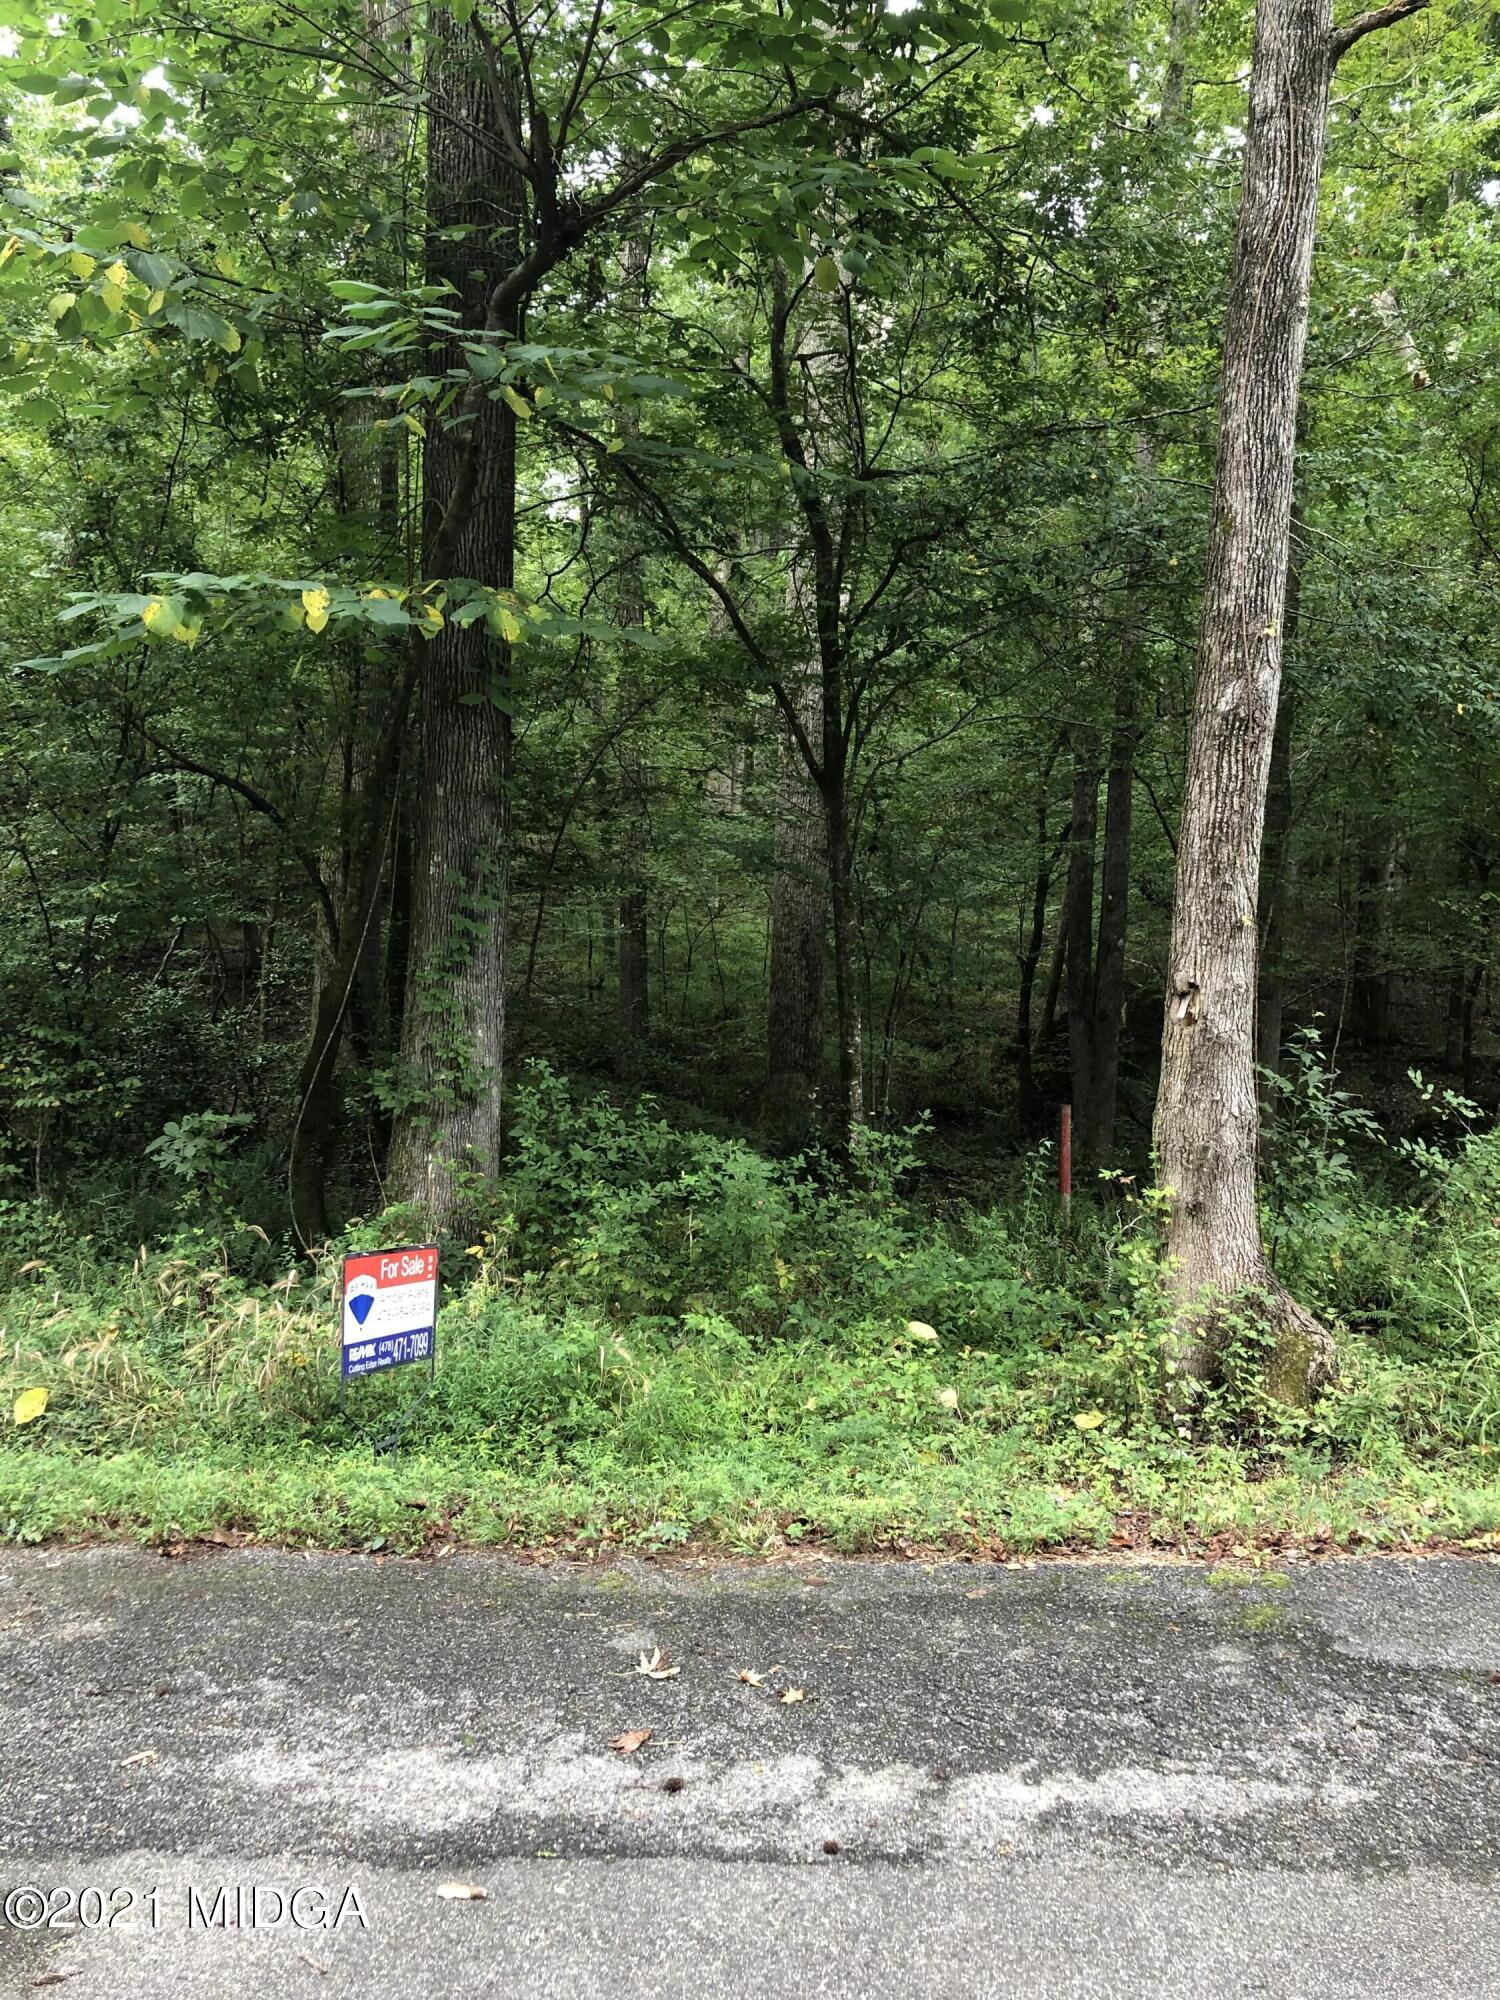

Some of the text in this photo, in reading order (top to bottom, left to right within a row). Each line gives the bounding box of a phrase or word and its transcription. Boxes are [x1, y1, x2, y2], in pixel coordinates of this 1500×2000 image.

[381, 1258, 399, 1280] For
[401, 1255, 424, 1277] Sale
[393, 1332, 428, 1362] 471-7099
[348, 1357, 392, 1373] Cutting Edge Realty
